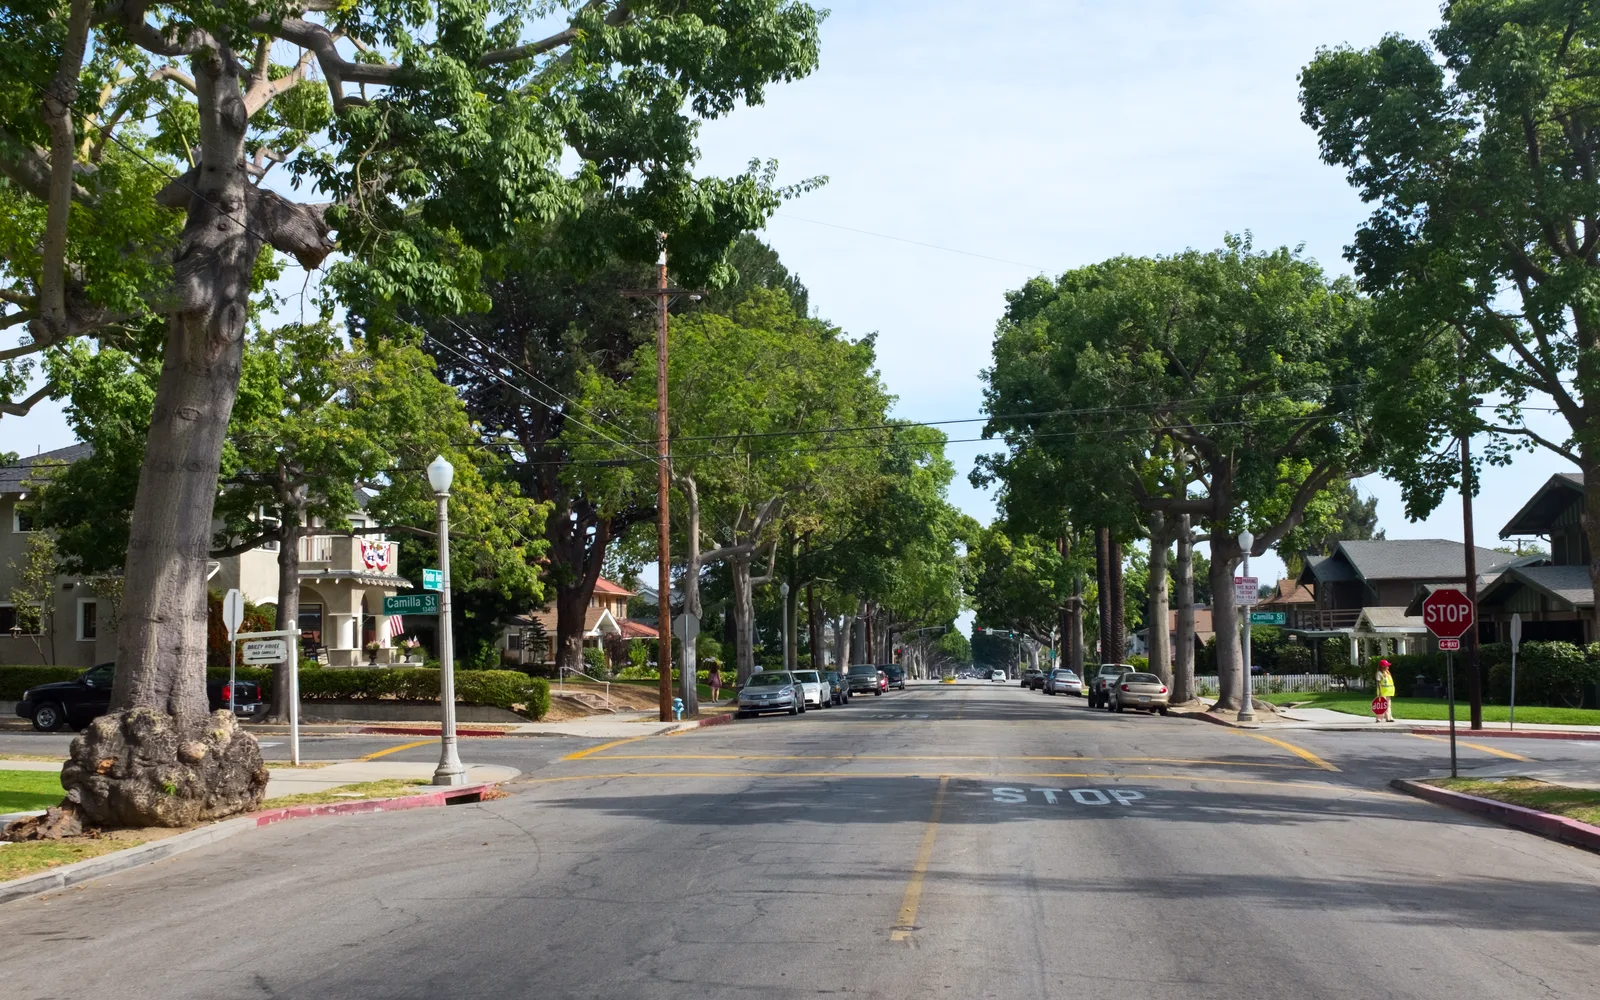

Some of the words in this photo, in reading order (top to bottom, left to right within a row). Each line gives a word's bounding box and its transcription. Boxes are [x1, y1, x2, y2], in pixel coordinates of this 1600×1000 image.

[387, 597, 421, 608] Camilla
[425, 595, 435, 606] St
[1427, 604, 1469, 622] STOP
[1372, 701, 1388, 710] STOP
[992, 787, 1146, 806] STOP
